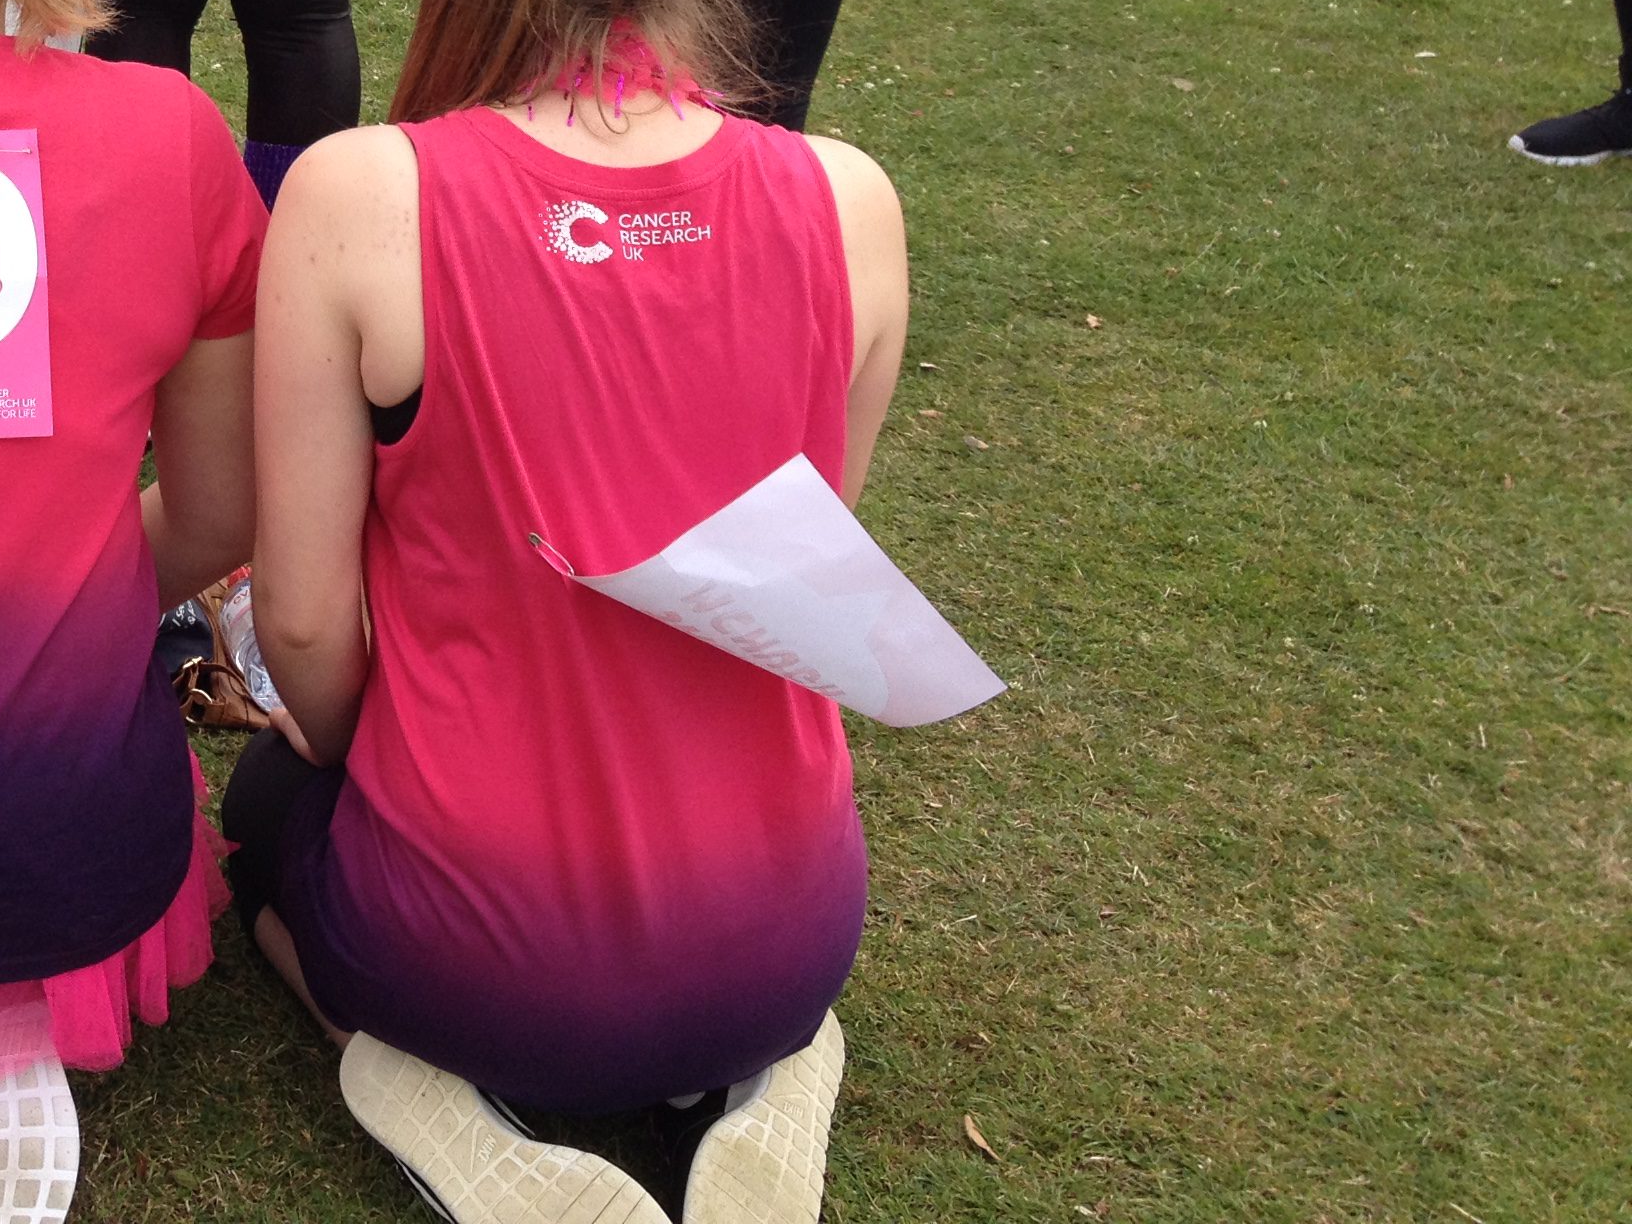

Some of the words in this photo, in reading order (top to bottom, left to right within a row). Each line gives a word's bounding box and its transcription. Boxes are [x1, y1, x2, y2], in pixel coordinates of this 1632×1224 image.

[618, 211, 692, 228] CANCER
[620, 225, 711, 246] RESEARCH
[622, 246, 644, 261] UK
[22, 398, 36, 407] UK
[18, 409, 36, 418] LIFE
